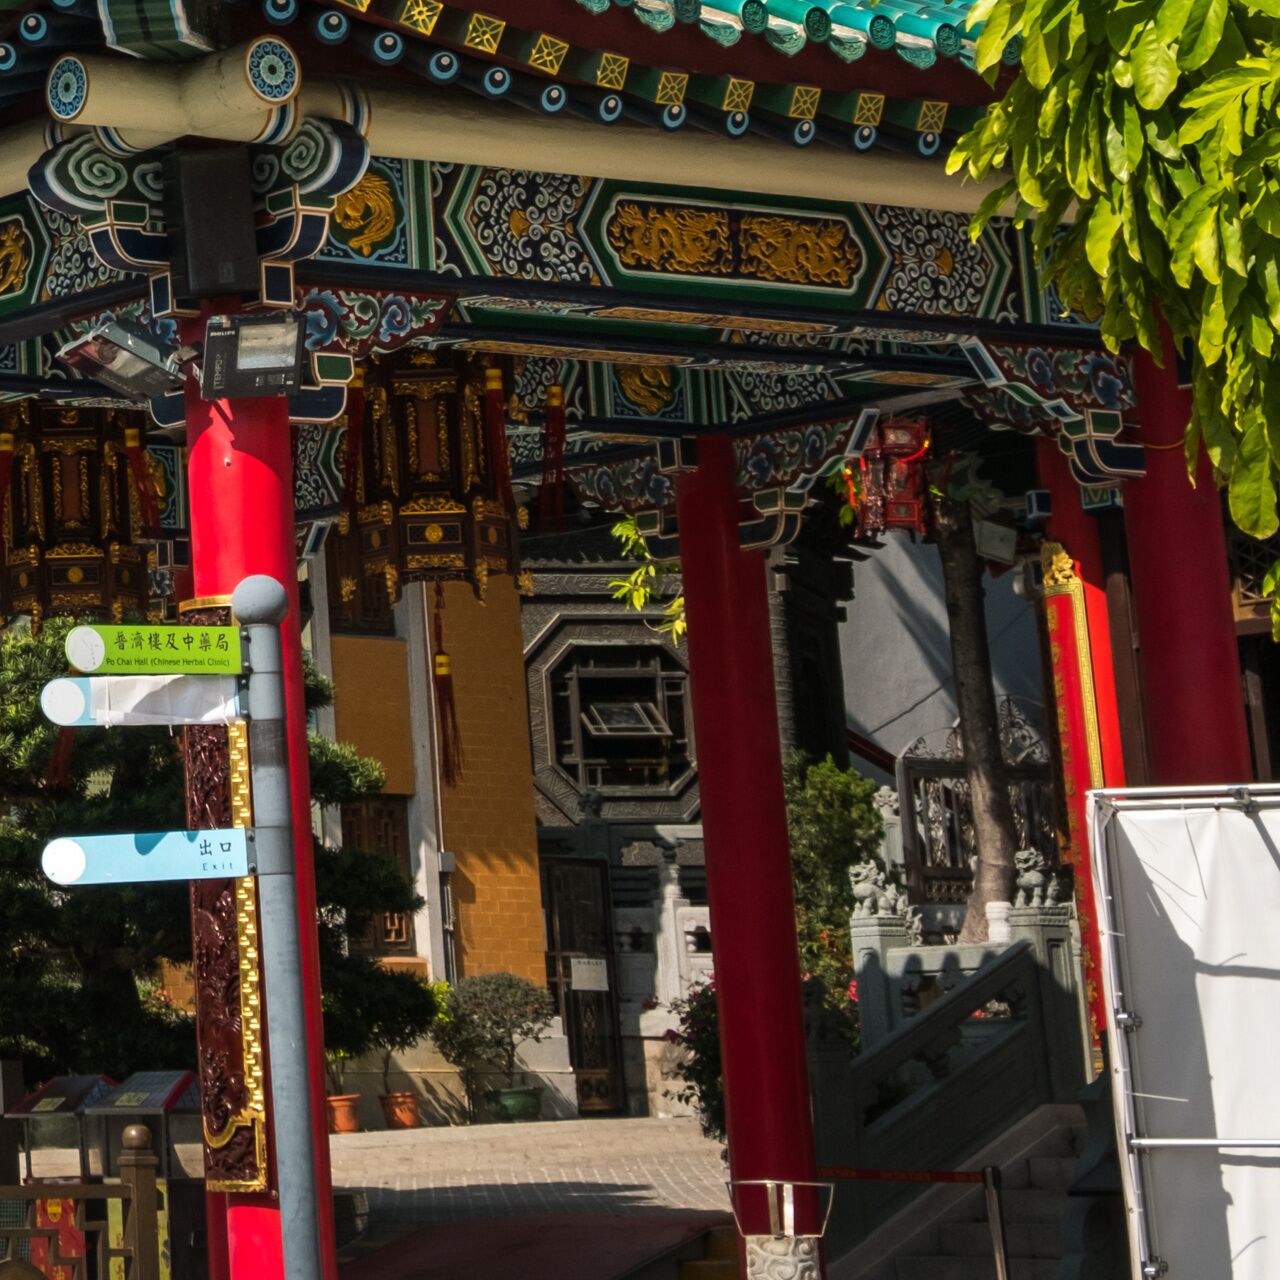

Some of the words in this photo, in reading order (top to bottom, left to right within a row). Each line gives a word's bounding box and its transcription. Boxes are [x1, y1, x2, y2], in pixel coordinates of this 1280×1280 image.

[113, 630, 230, 653] 普濟樓及中藥局
[106, 657, 115, 666] Po
[116, 657, 133, 667] Chai
[134, 657, 149, 667] Hall
[150, 657, 181, 667] (Chinese
[182, 657, 206, 667] Herbal
[207, 657, 230, 668] Clinic)
[199, 839, 233, 856] 出口
[202, 862, 234, 872] Exit
